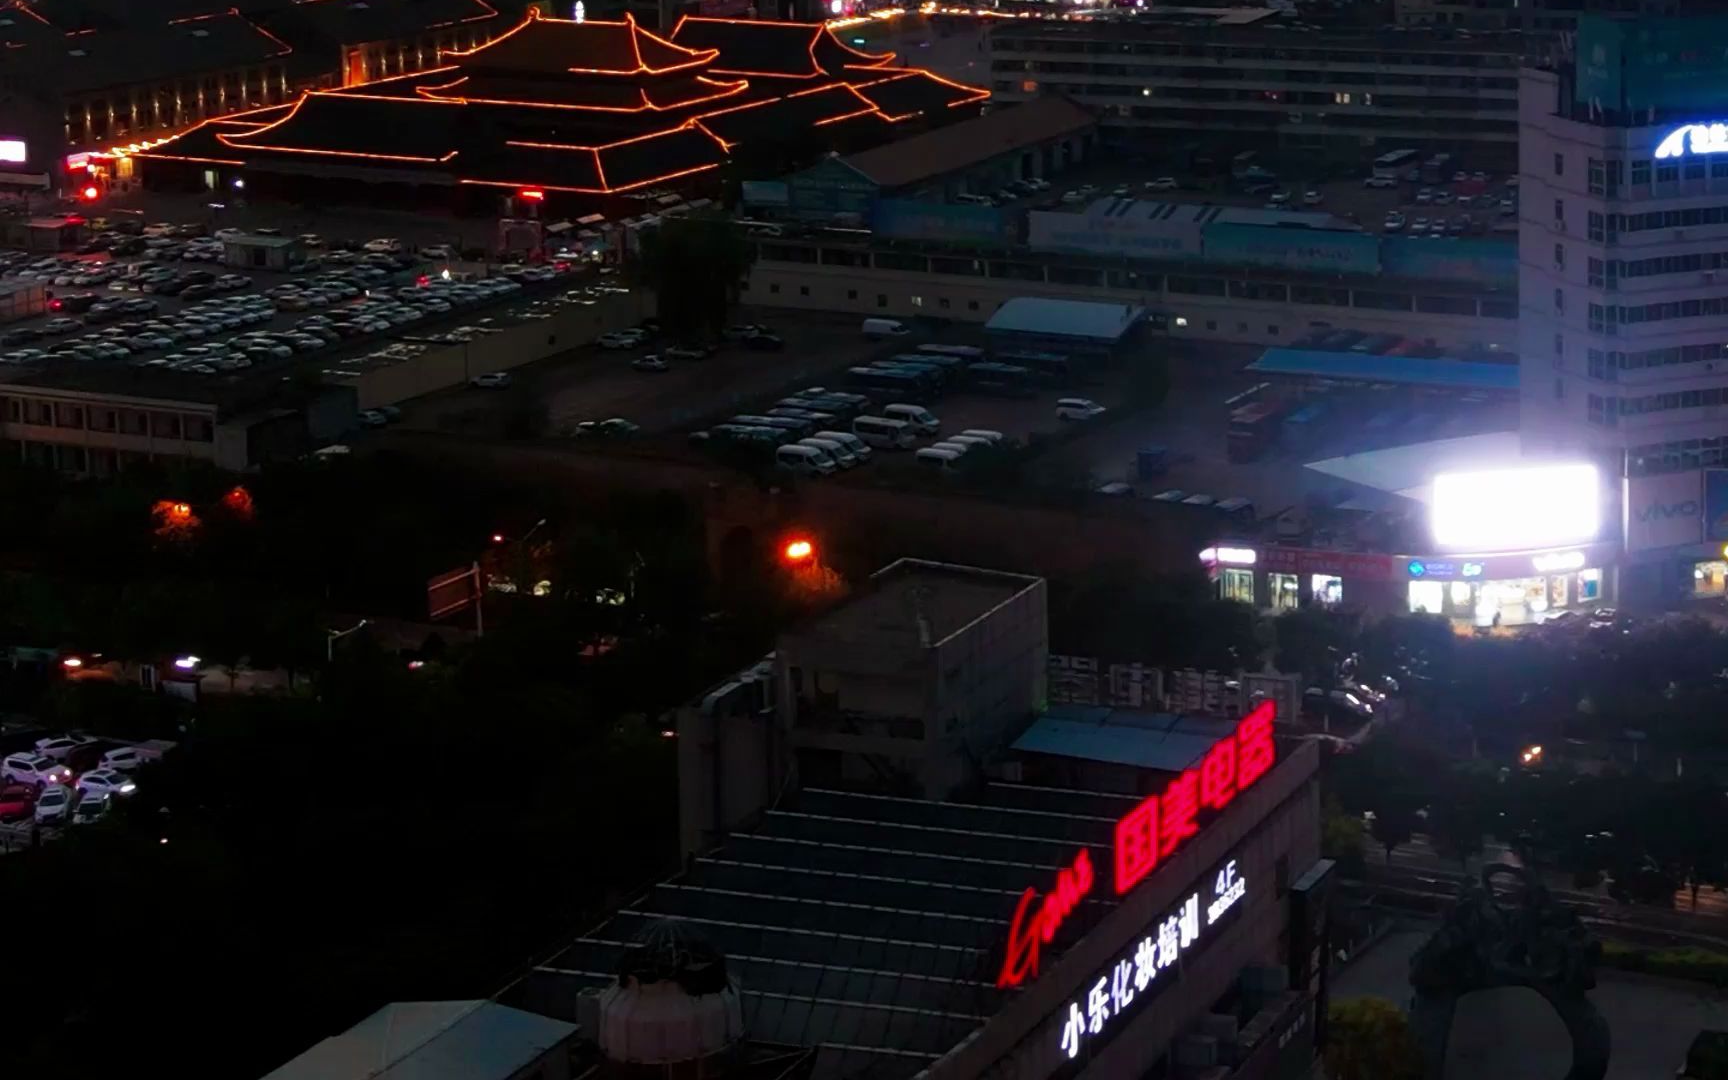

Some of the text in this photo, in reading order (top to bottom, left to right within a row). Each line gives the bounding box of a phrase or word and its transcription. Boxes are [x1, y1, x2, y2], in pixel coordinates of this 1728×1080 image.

[1639, 499, 1698, 523] vivo
[1115, 700, 1276, 895] 国美电器
[1061, 892, 1199, 1059] 小乐化妆培训
[1215, 859, 1237, 894] 4F
